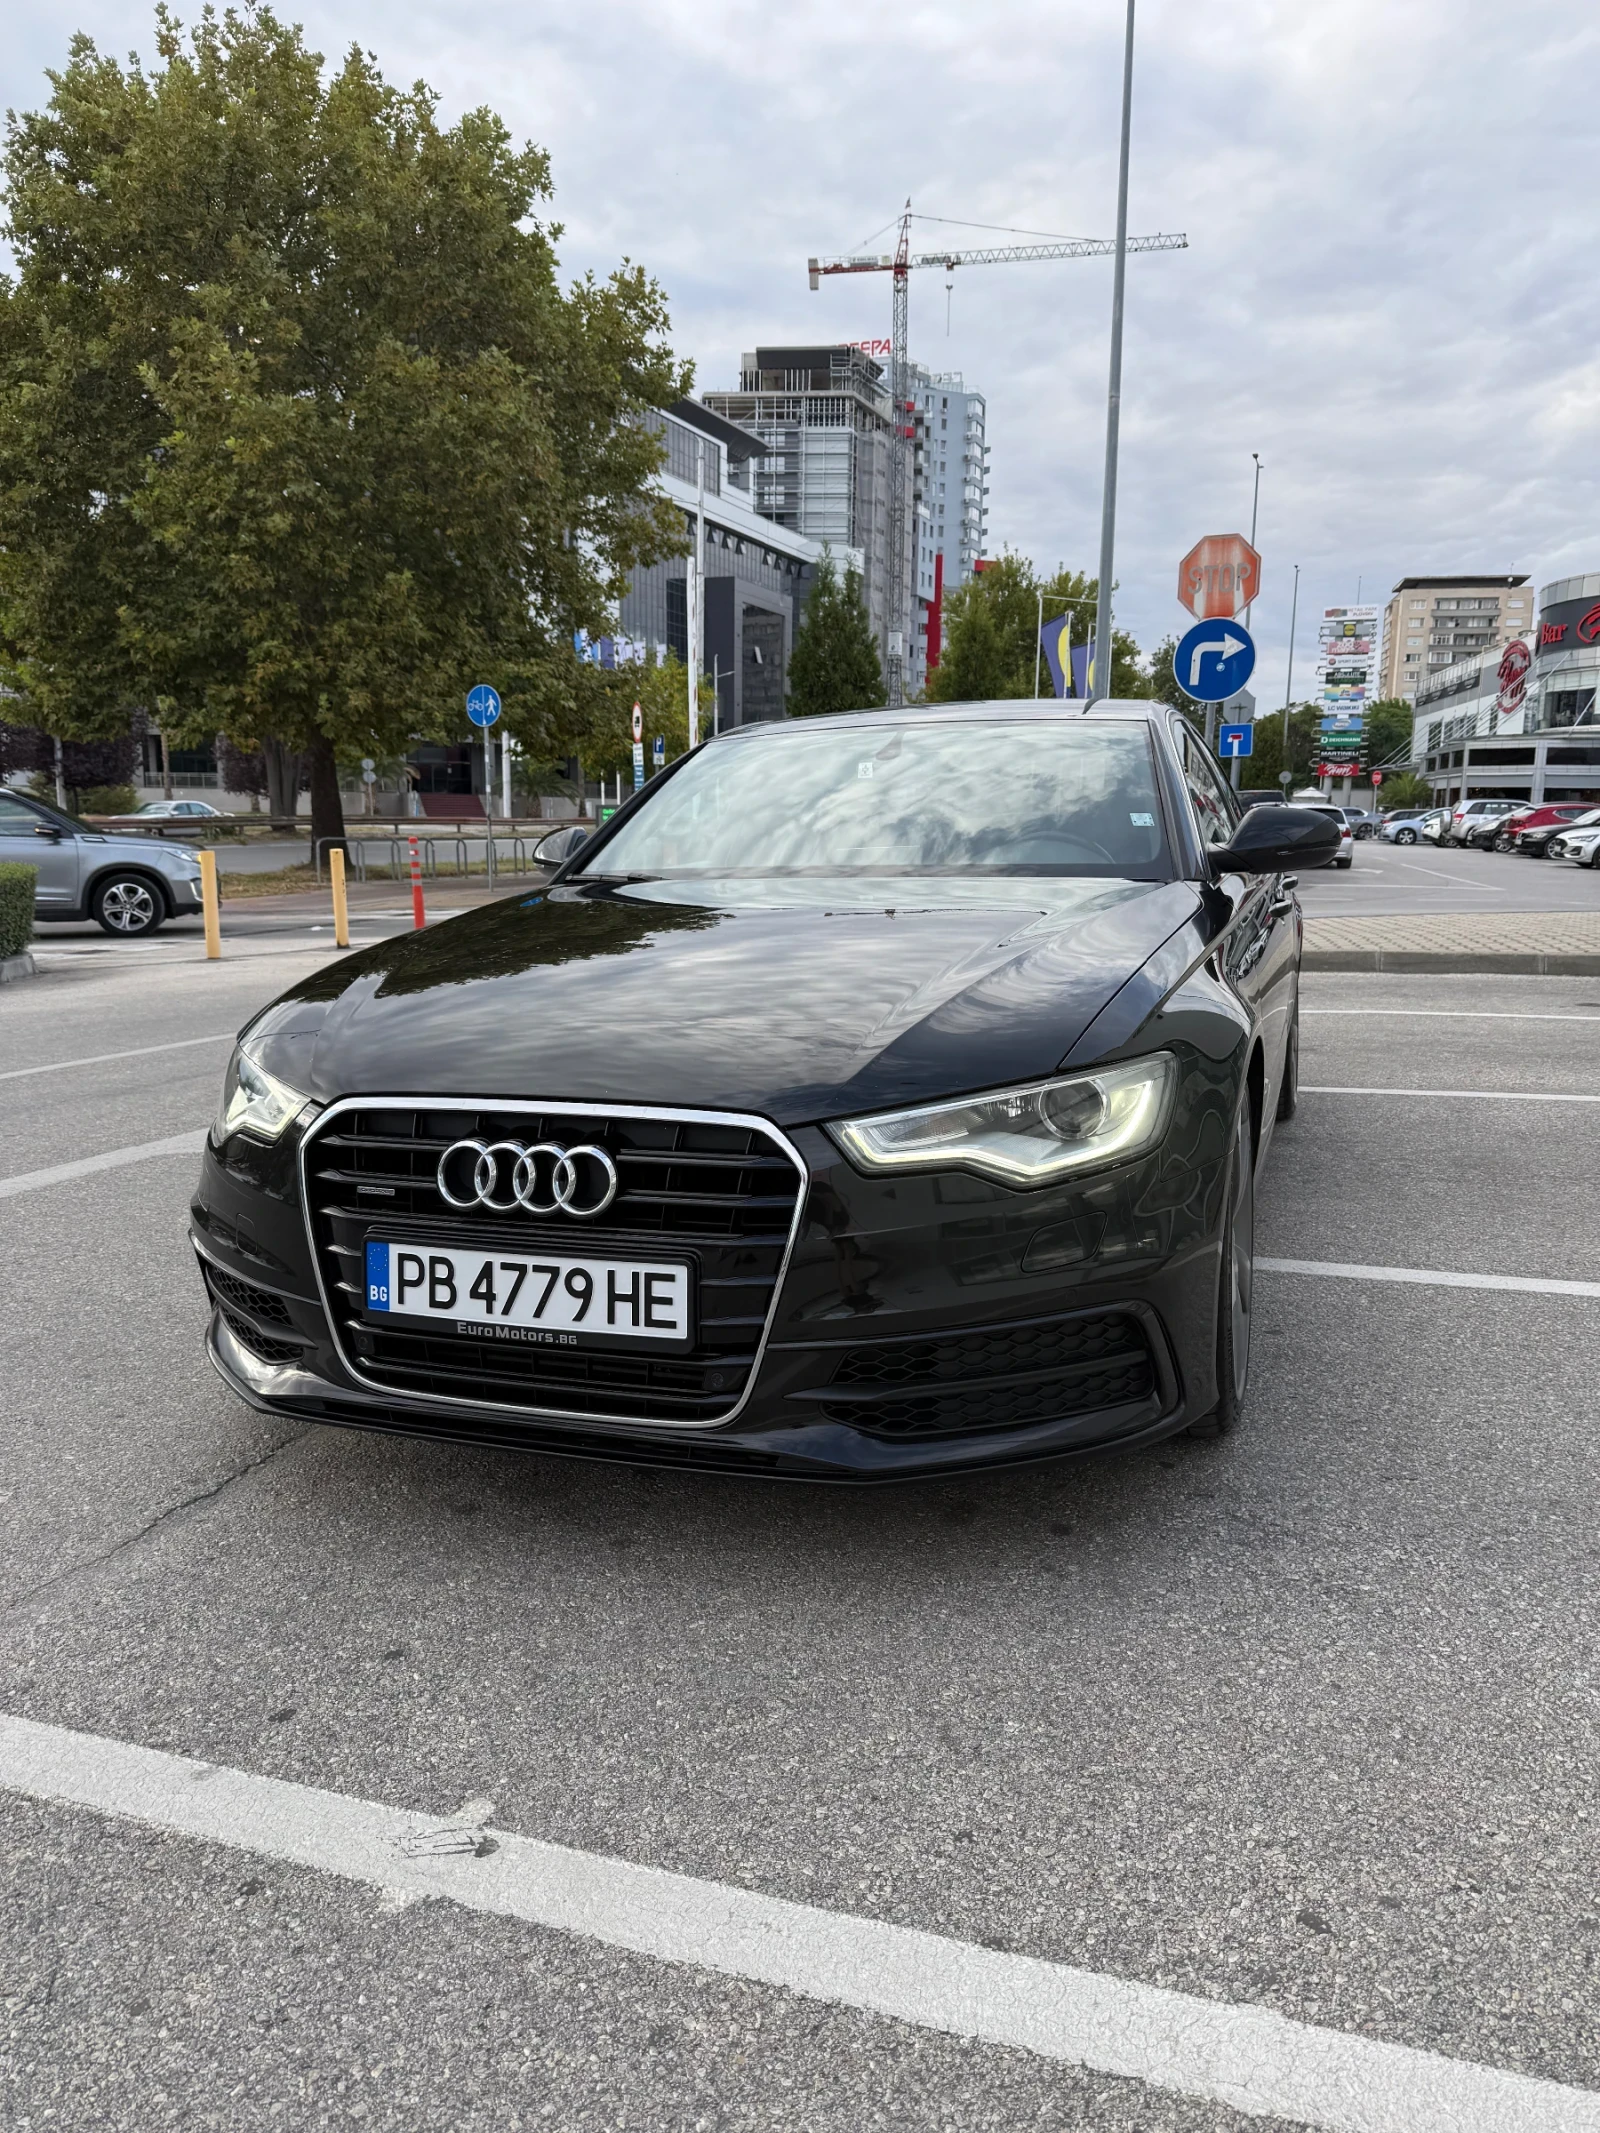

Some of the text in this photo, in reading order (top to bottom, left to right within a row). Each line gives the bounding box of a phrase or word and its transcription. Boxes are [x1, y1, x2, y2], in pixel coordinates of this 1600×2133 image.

[1187, 563, 1251, 595] STOP
[1541, 622, 1568, 645] Bar
[370, 1285, 388, 1302] BG
[397, 1252, 678, 1330] PB 4779 HE
